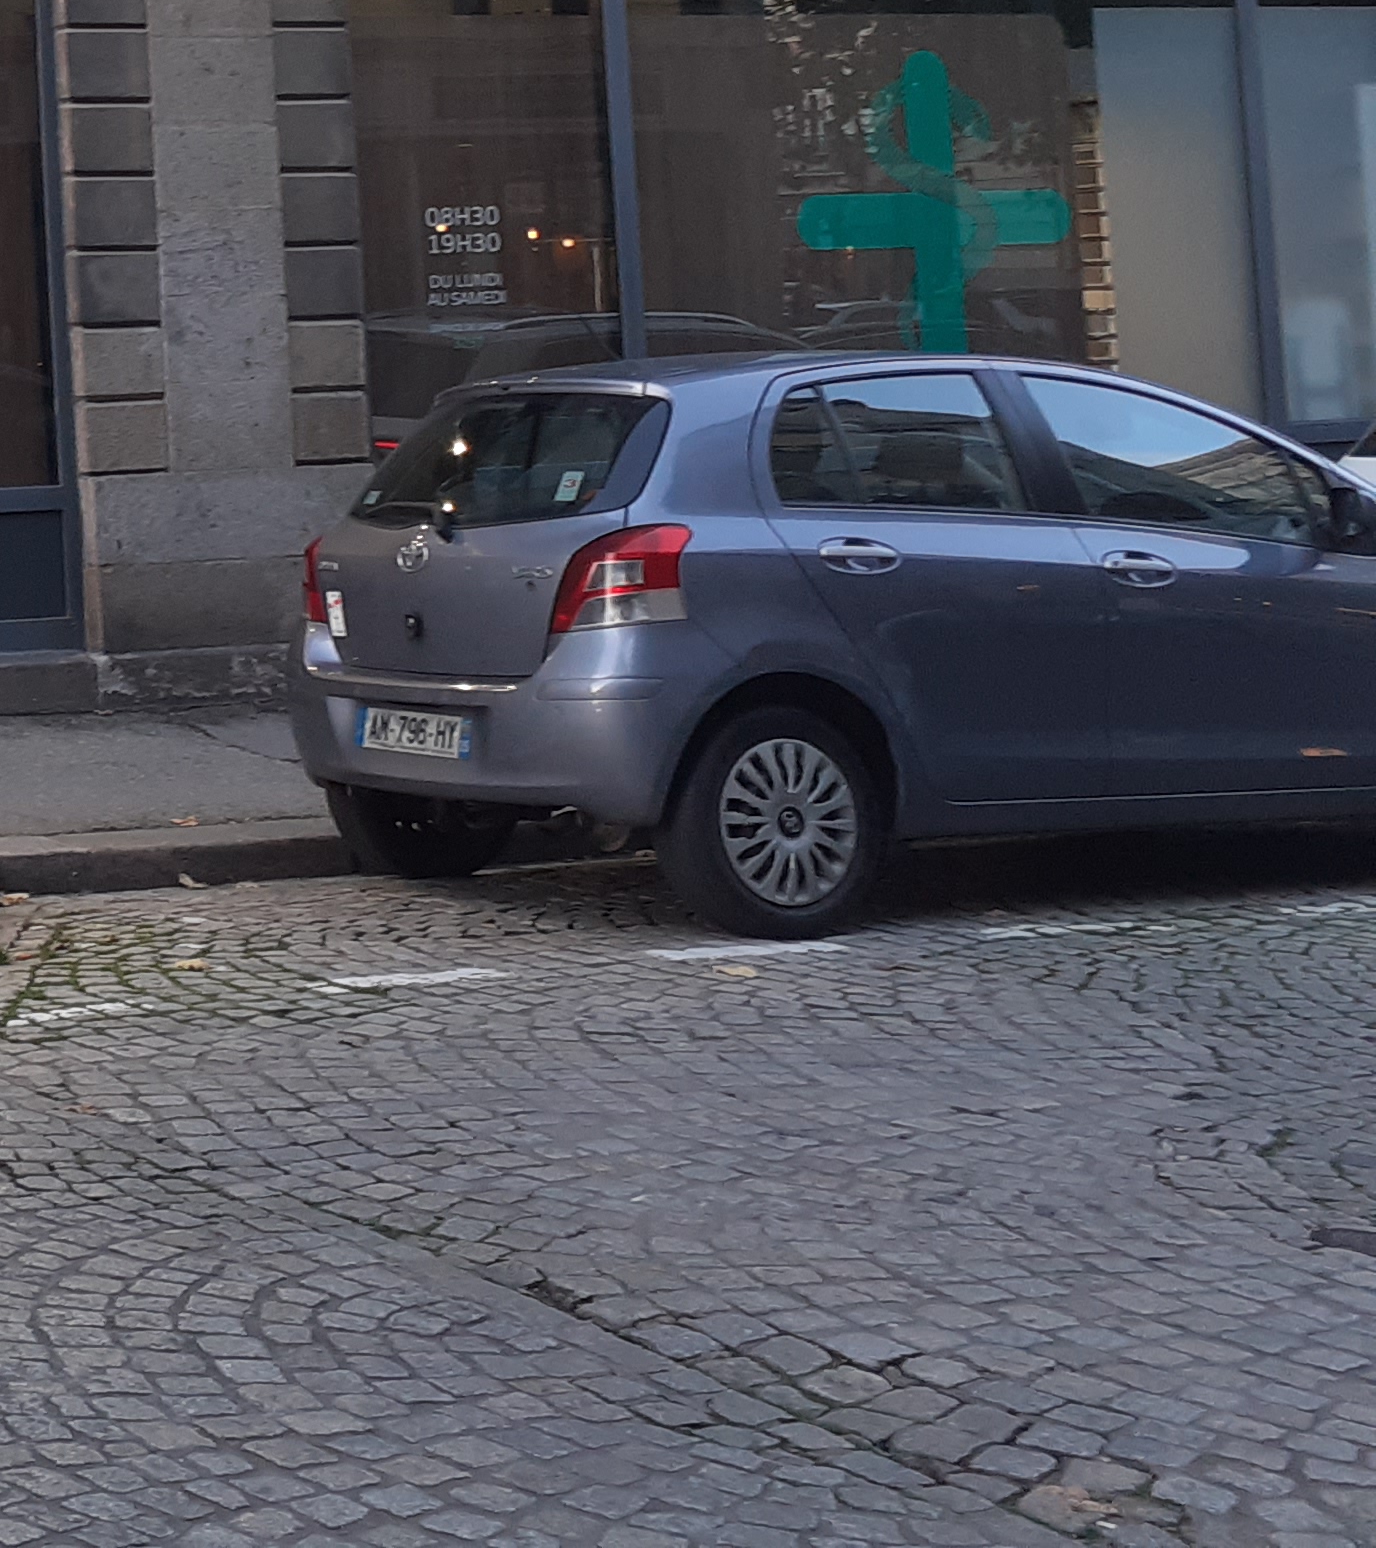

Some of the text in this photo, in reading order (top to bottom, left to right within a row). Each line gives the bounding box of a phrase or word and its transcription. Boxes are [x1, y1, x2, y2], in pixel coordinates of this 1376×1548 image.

[424, 205, 501, 228] 08H30
[427, 232, 503, 255] 19H30
[427, 272, 504, 289] DU LUNDI
[427, 290, 508, 307] AU SAMEDI
